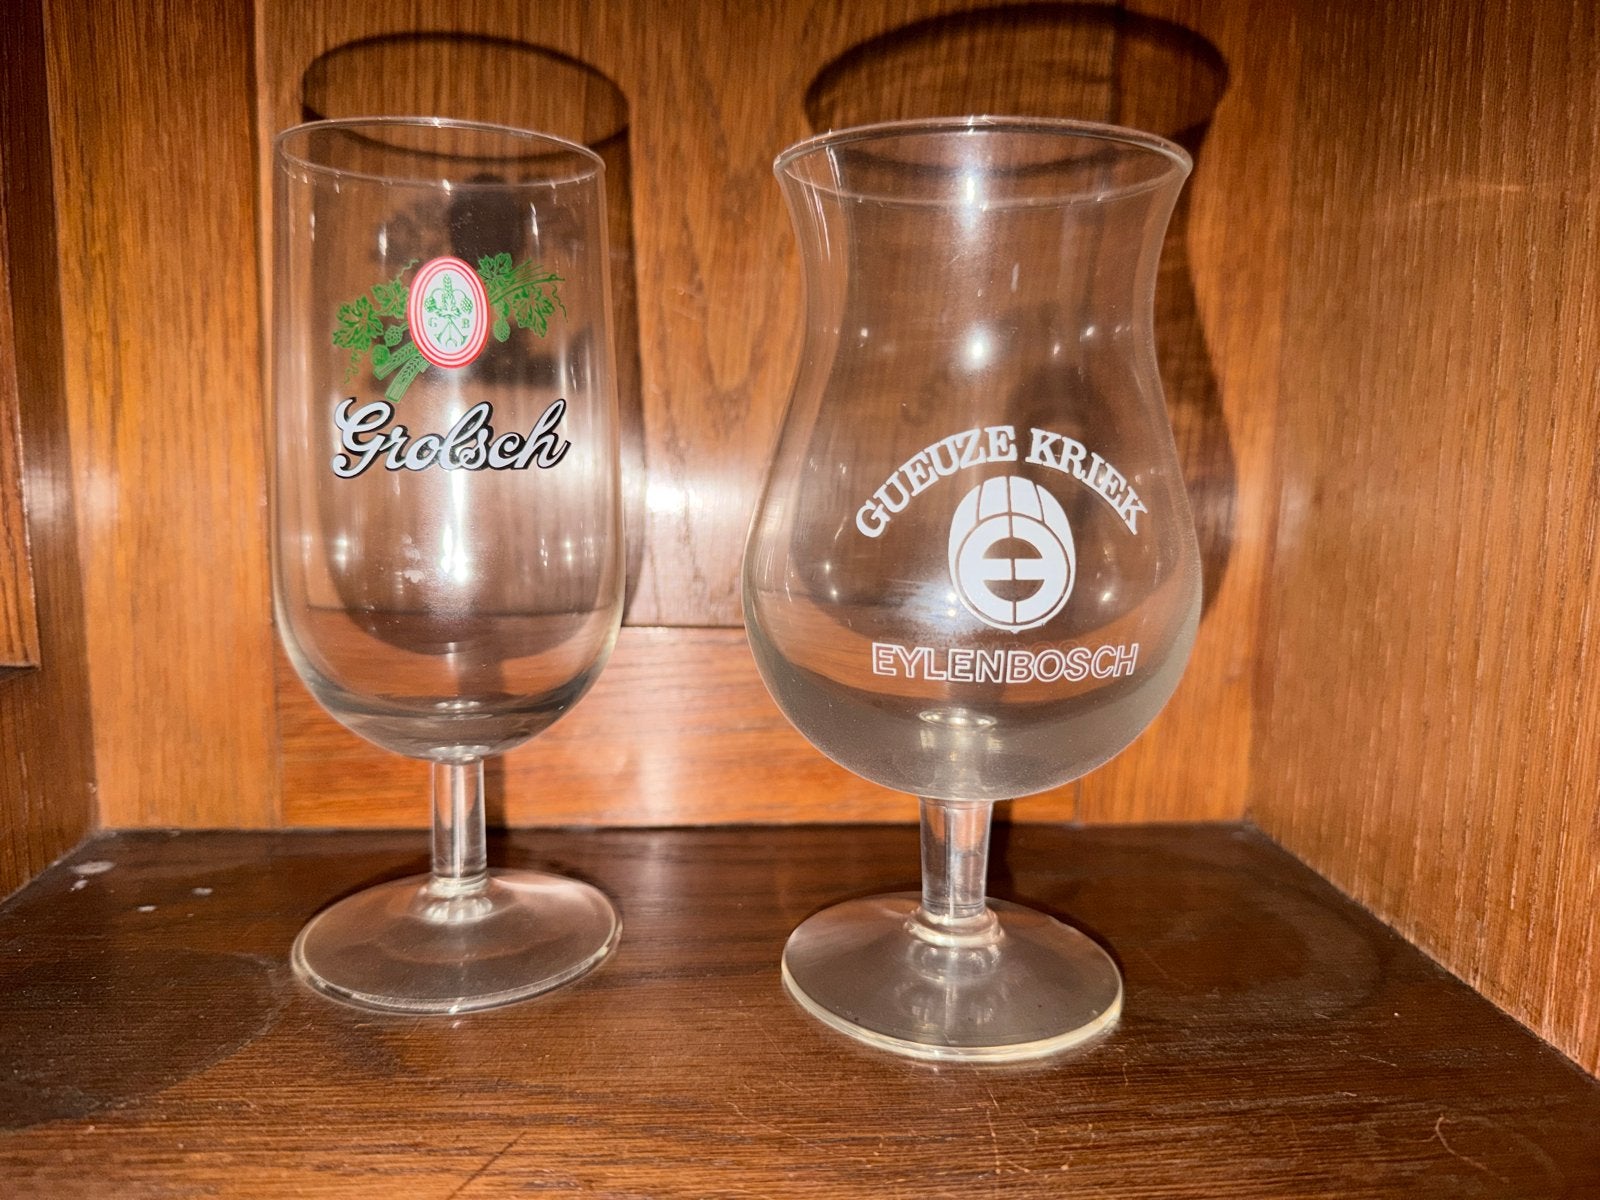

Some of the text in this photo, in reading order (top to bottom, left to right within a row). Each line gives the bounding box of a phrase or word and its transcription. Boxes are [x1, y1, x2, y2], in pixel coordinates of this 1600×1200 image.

[332, 397, 572, 479] Grolsch
[855, 425, 1148, 538] GUEUZE KRIEK
[871, 642, 1139, 684] EYLENBOSCH
